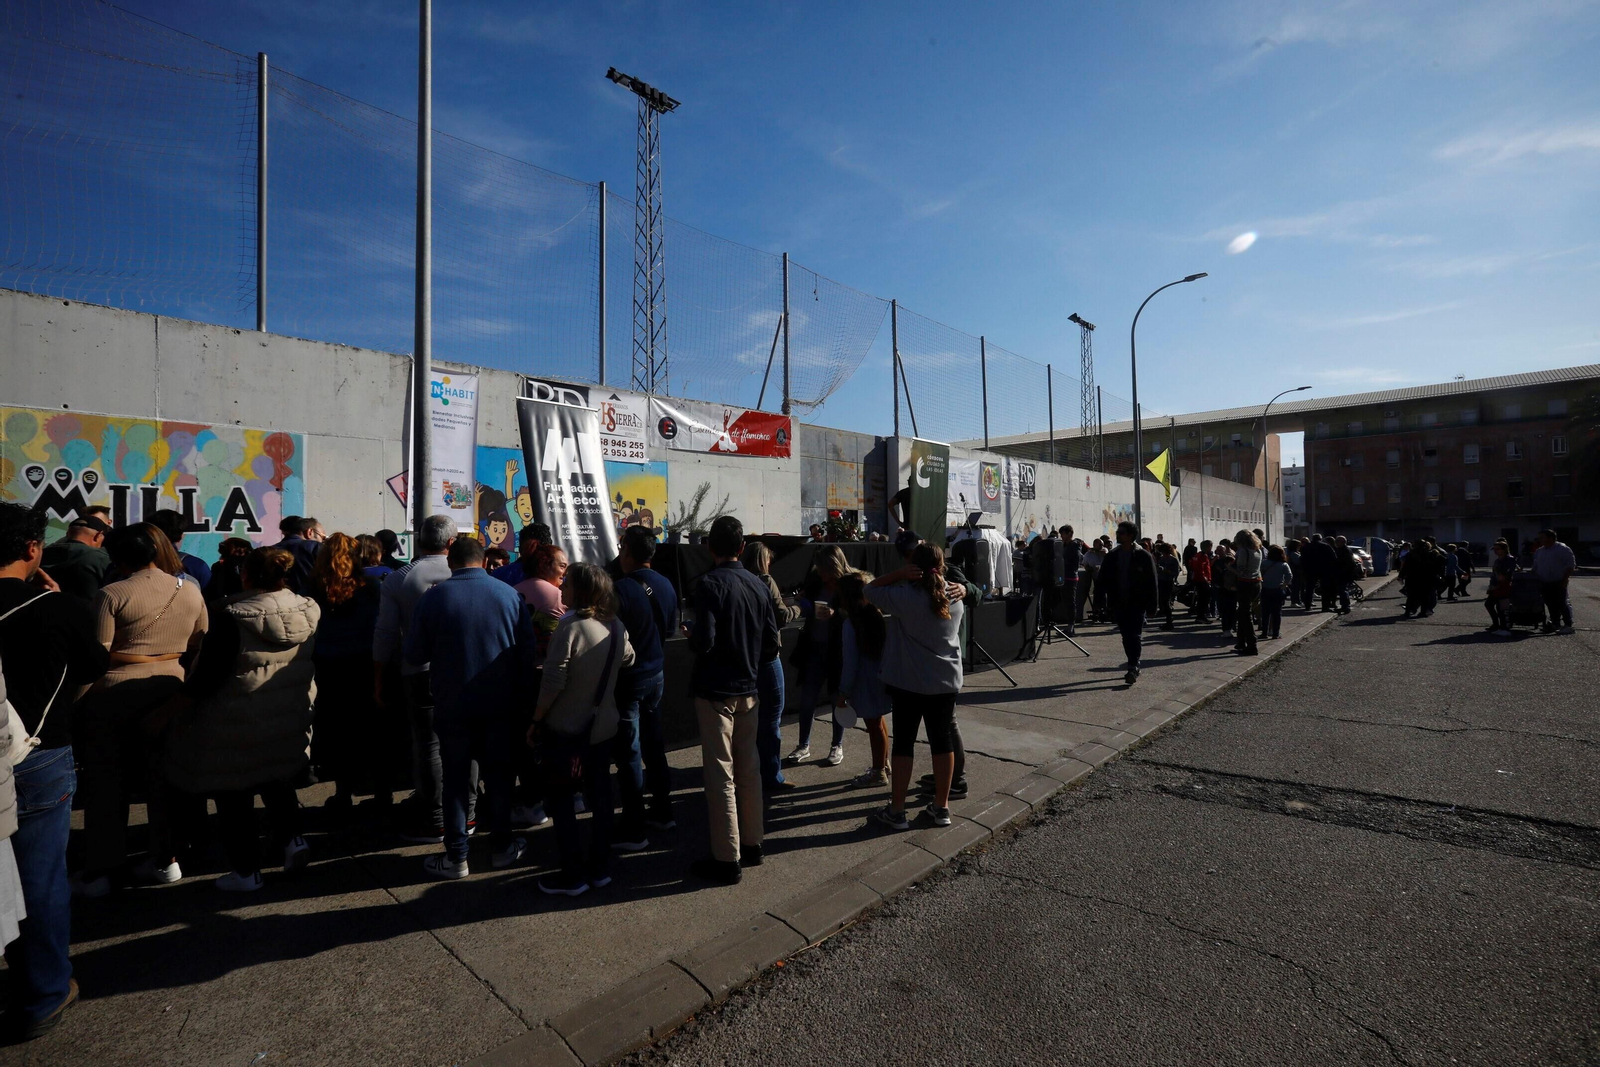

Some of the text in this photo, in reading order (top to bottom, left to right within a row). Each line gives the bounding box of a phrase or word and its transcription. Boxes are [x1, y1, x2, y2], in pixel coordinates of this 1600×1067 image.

[445, 387, 475, 401] HABIT
[433, 423, 456, 431] Medianas
[731, 428, 740, 438] de
[740, 428, 771, 443] flamenco
[611, 439, 627, 448] 945
[629, 441, 645, 450] 255
[603, 448, 645, 459] 2 953 243
[432, 467, 465, 475] nhabit-h2020.eu
[543, 481, 601, 493] Funación
